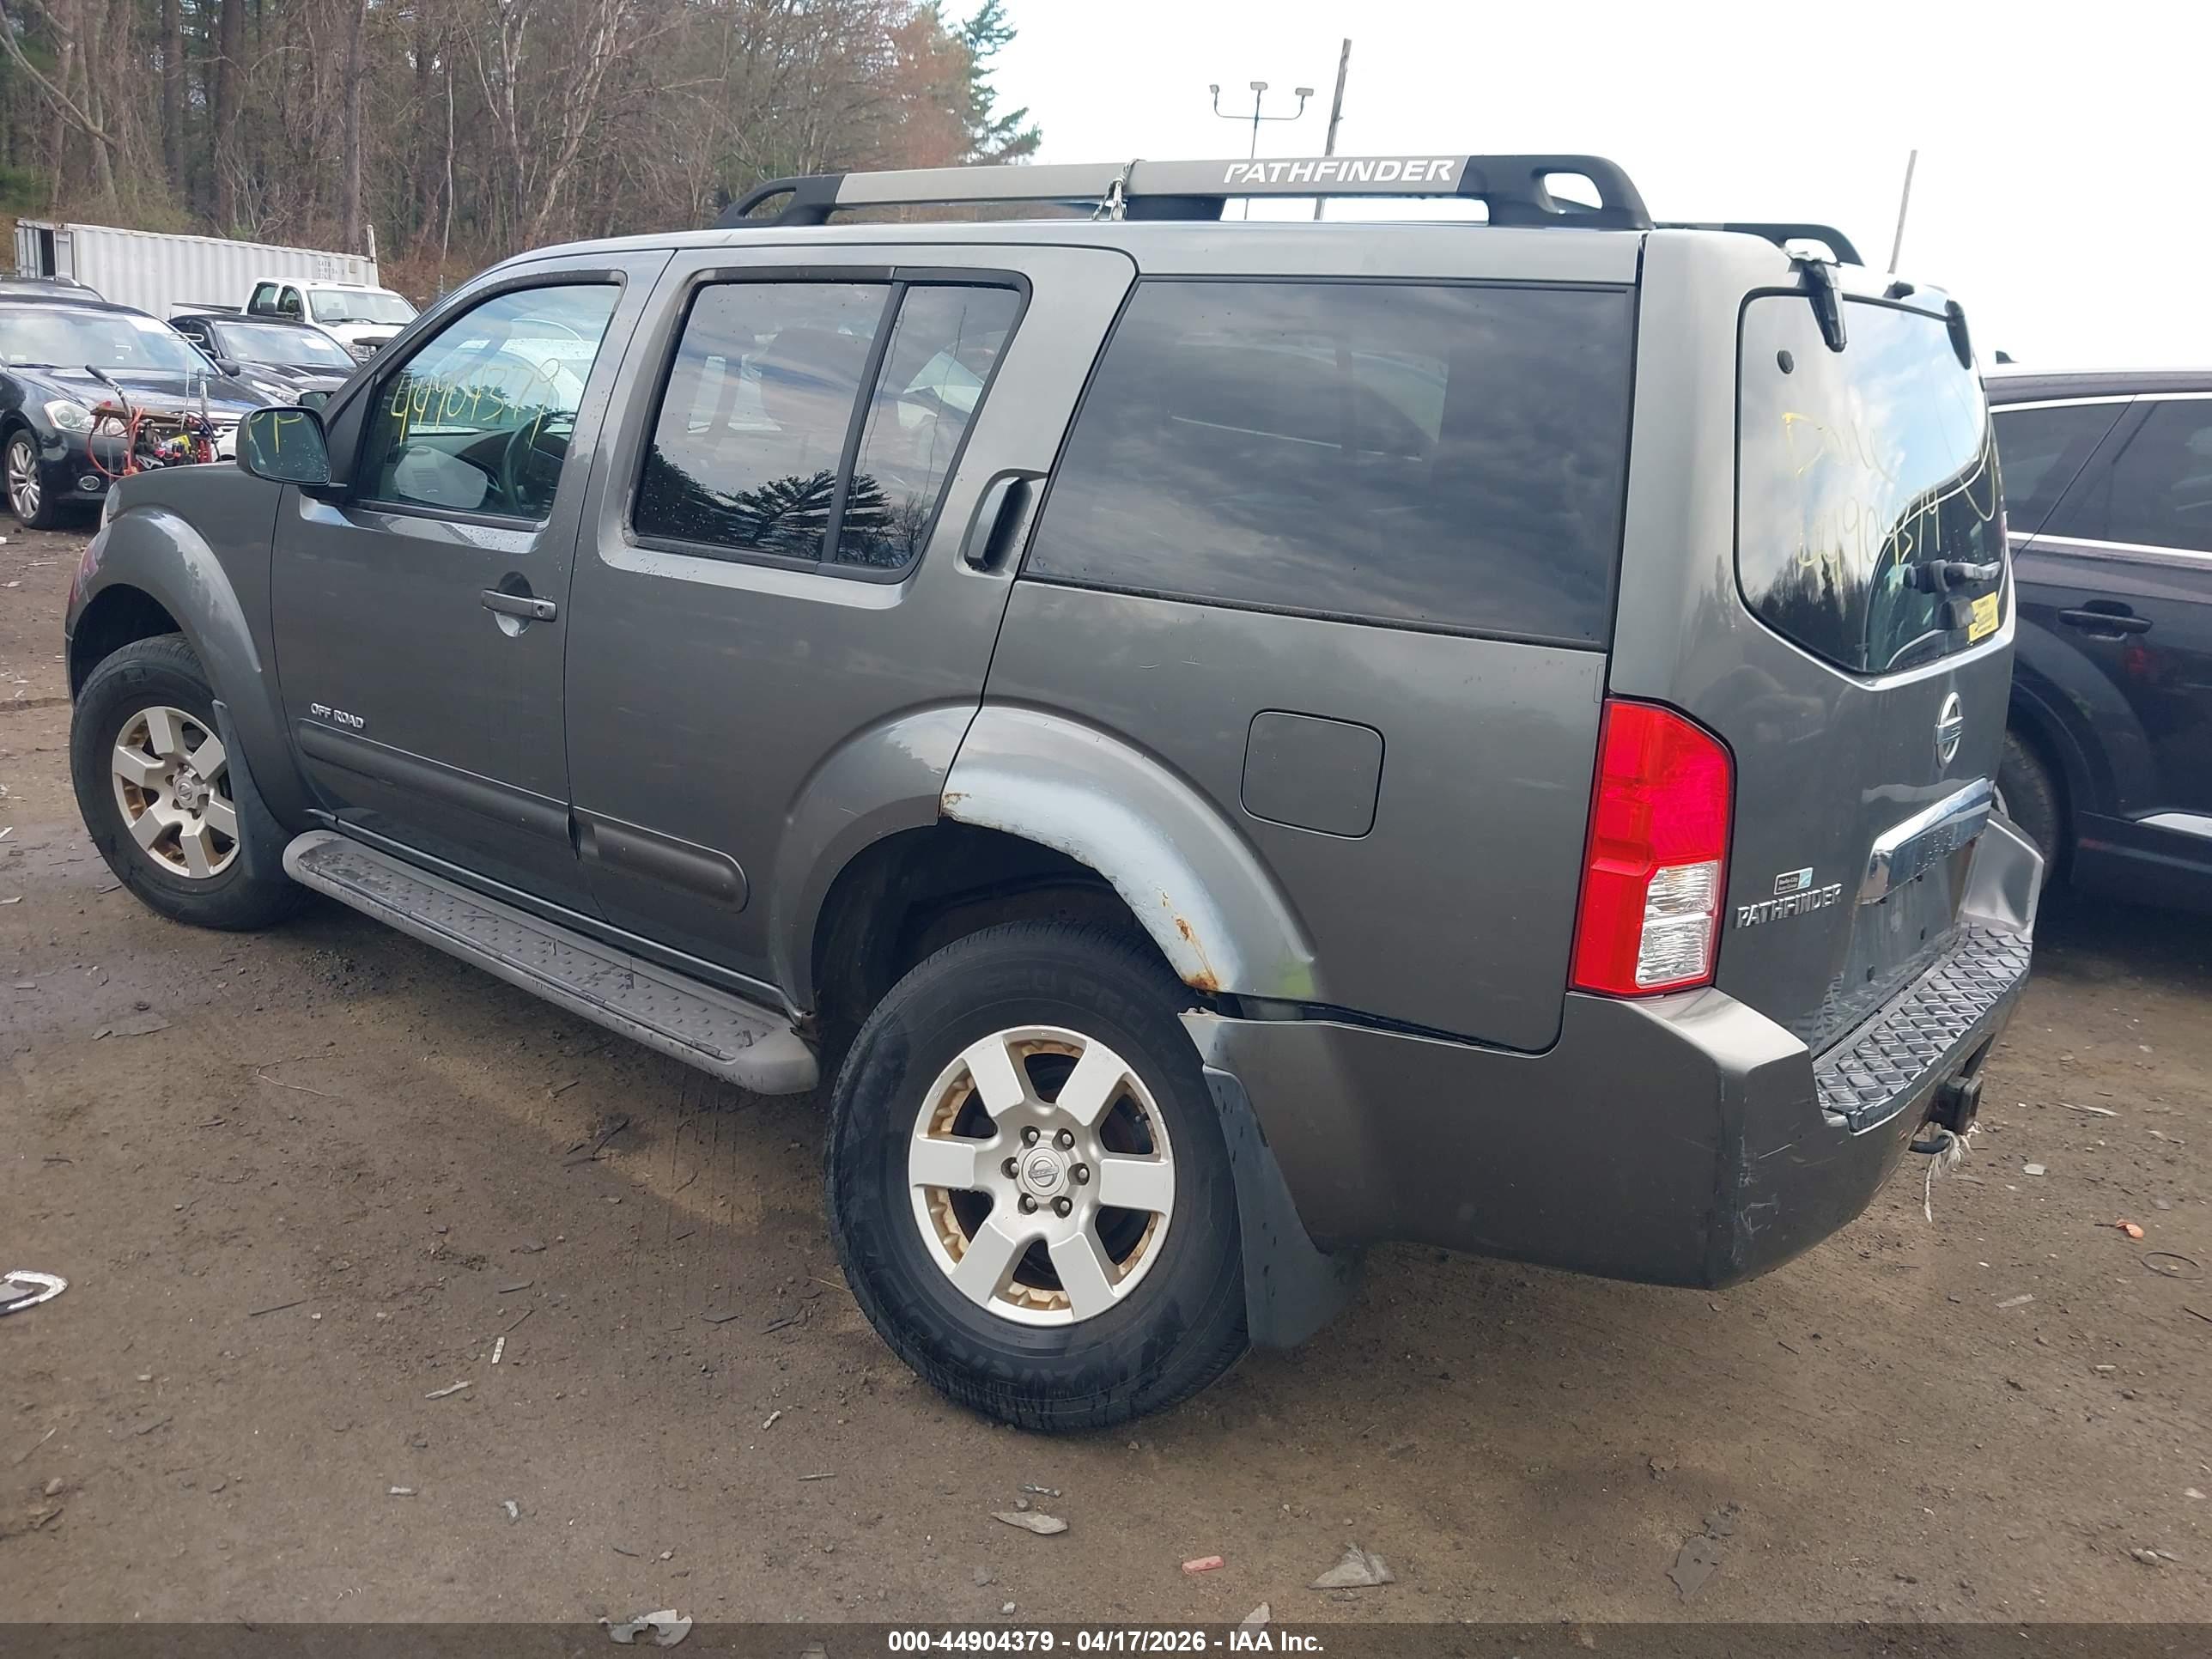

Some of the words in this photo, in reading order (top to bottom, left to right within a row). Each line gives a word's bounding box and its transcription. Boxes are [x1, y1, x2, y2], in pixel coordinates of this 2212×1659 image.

[1223, 160, 1455, 184] PATHFINDER
[310, 702, 331, 719] OFF
[333, 709, 364, 729] ROAD
[1735, 883, 1843, 928] PATHFINDER
